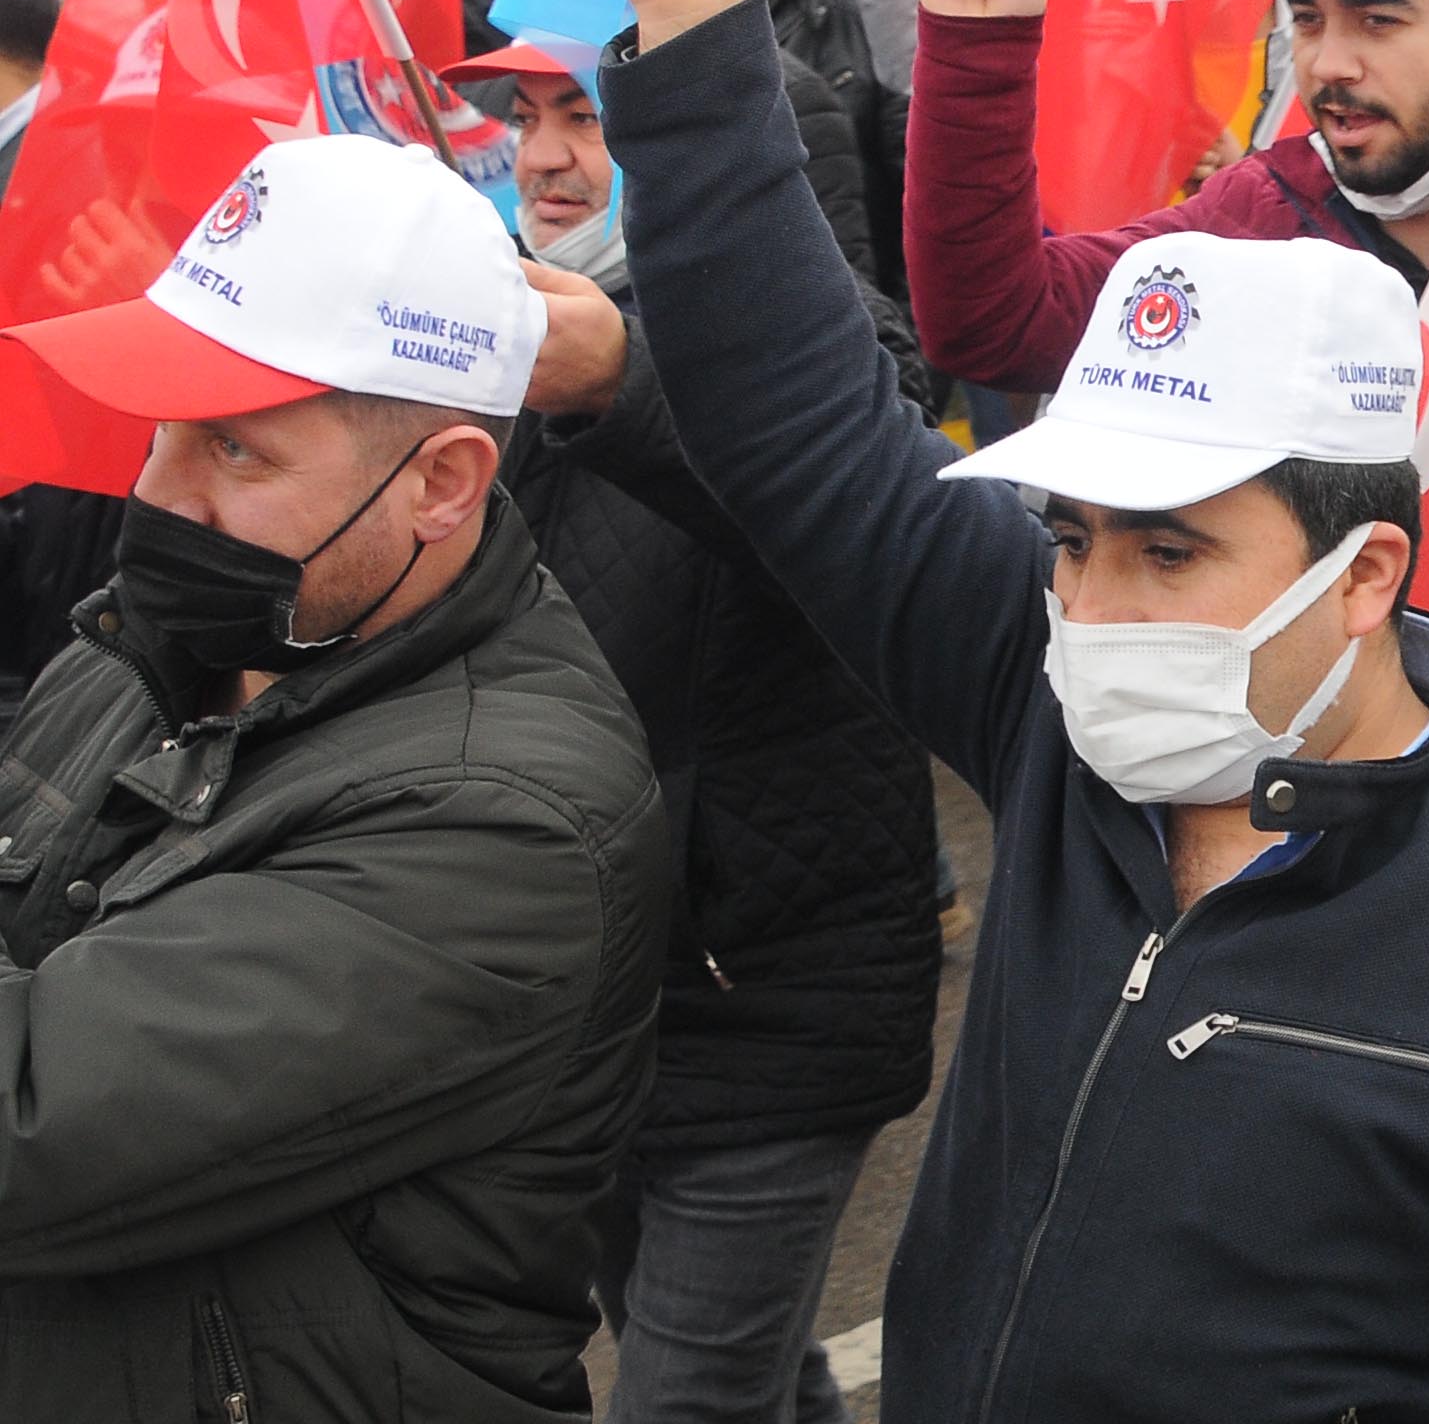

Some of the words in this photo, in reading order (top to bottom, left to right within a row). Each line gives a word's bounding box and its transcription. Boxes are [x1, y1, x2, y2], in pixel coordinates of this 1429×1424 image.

[186, 262, 243, 307] METAL
[1079, 363, 1127, 388] TÜRK
[1131, 370, 1212, 403] METAL
